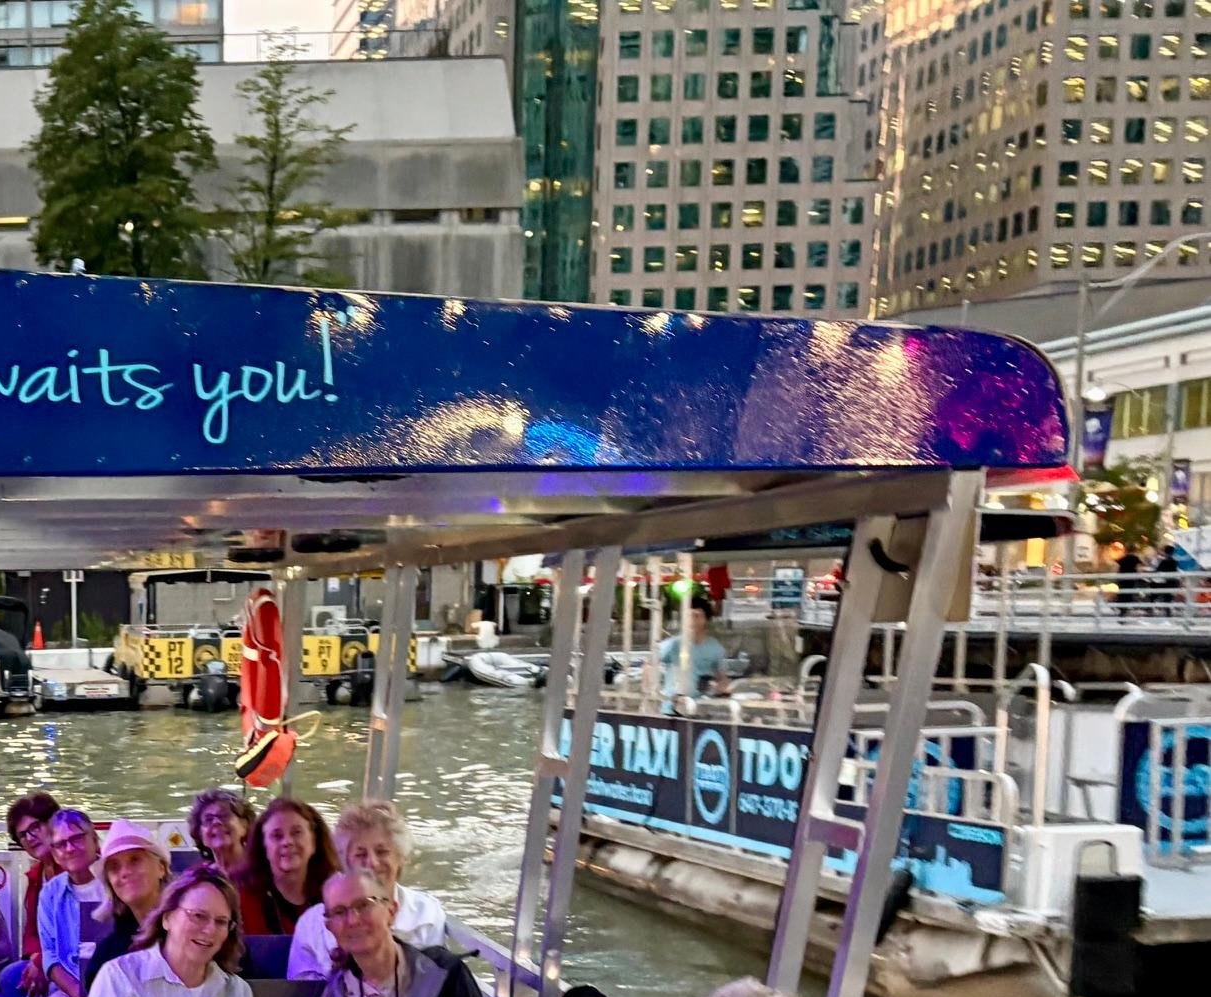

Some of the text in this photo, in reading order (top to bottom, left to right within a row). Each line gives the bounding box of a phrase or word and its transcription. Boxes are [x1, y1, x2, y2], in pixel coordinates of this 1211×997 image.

[168, 641, 184, 657] PT
[318, 645, 331, 658] PT
[168, 657, 183, 674] 12
[619, 725, 680, 780] TAXI
[739, 737, 812, 791] TDO
